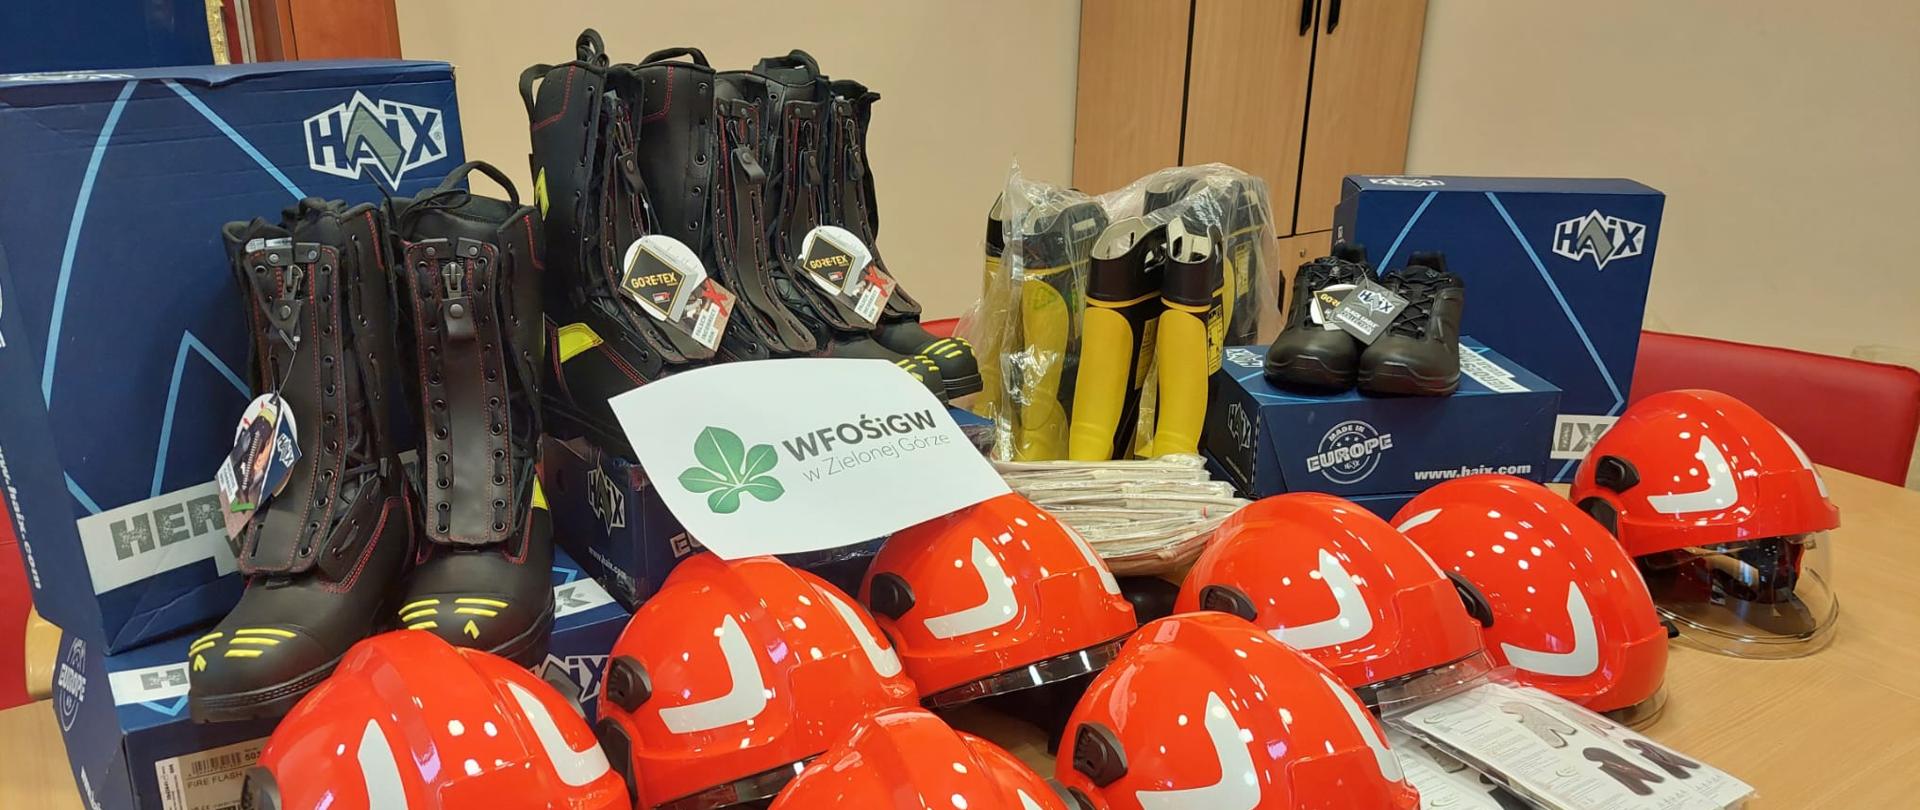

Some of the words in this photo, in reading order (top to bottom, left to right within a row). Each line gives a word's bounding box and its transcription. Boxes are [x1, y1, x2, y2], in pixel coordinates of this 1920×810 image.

[631, 271, 677, 289] GORE-TEX
[782, 410, 936, 462] WFOŚiGW
[1329, 425, 1353, 442] MADE
[1355, 425, 1366, 434] IN
[802, 467, 821, 482] w
[821, 445, 900, 476] Zielonej
[898, 433, 951, 452] Górze
[1306, 433, 1393, 473] EUROPE
[1414, 464, 1532, 481] www.haix.com
